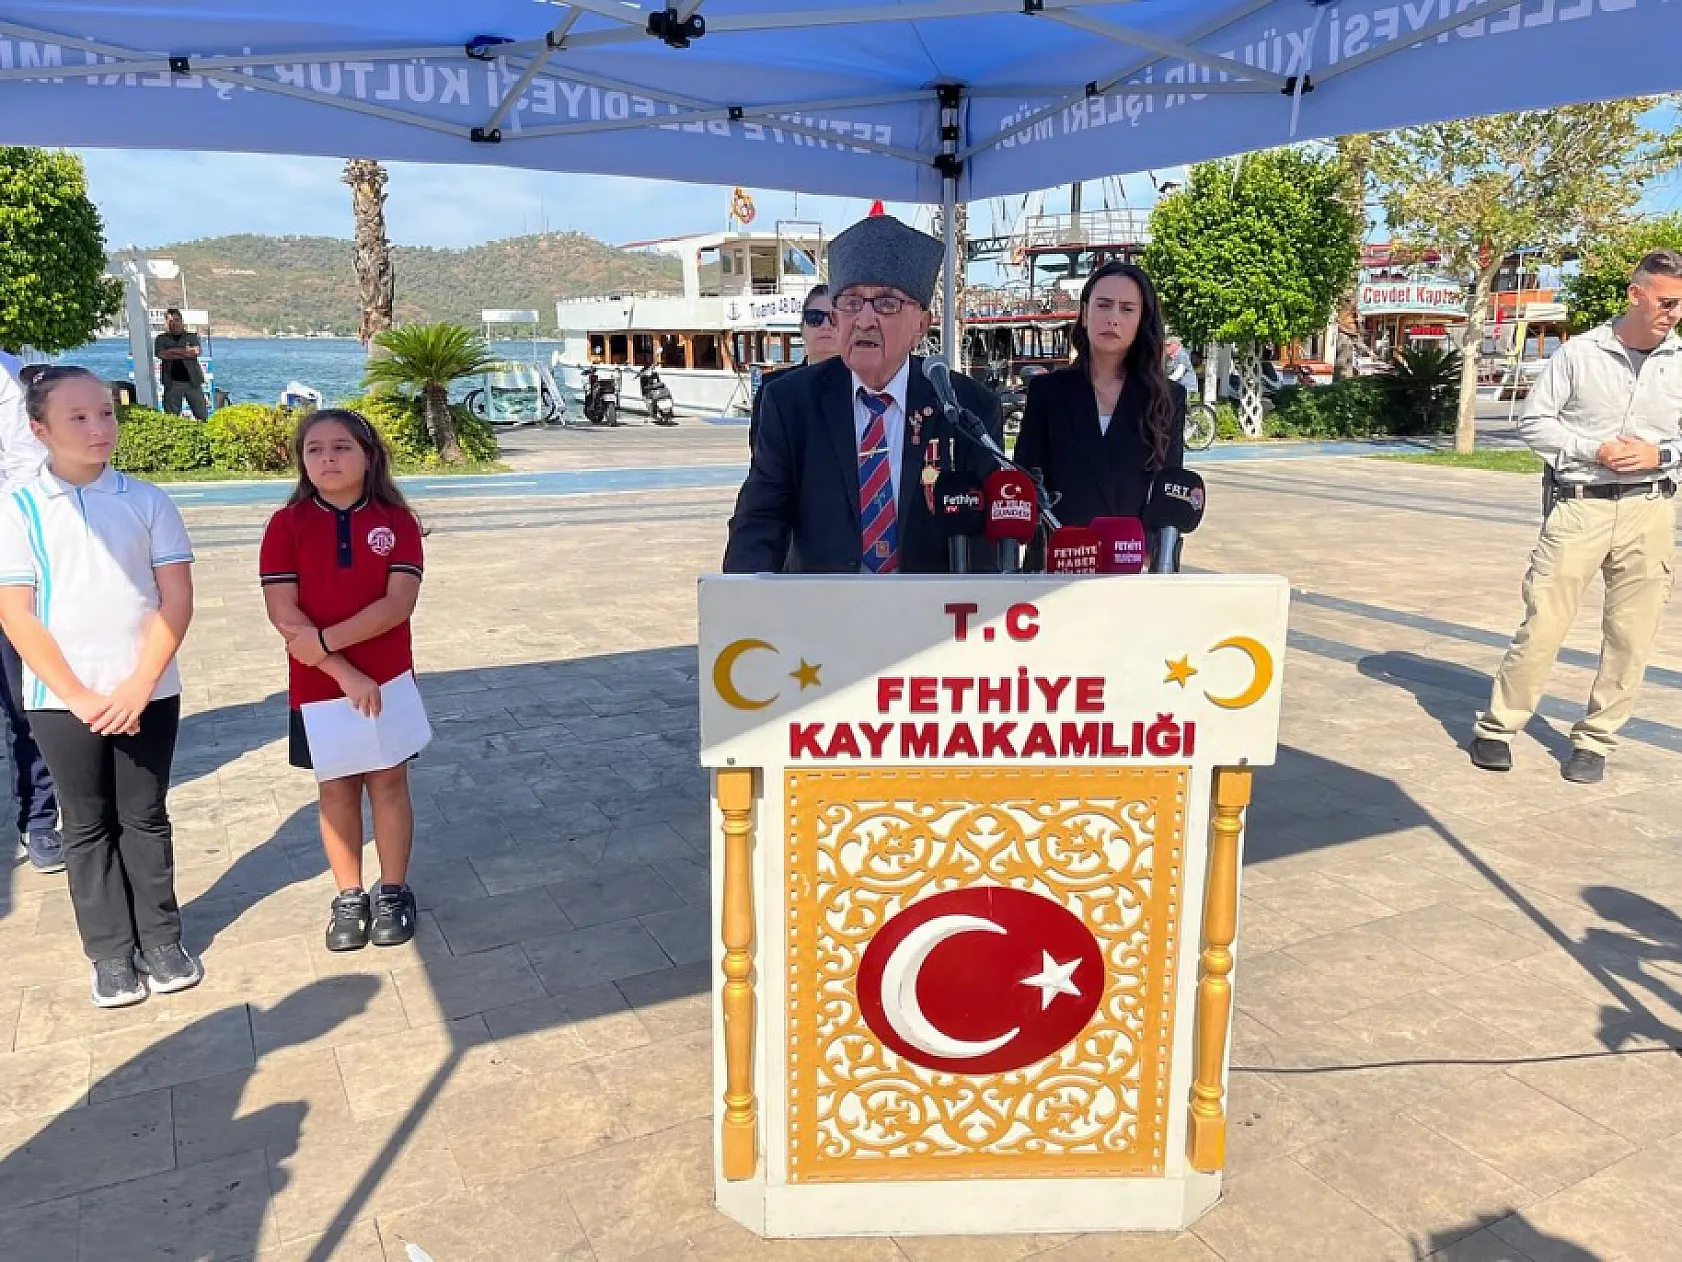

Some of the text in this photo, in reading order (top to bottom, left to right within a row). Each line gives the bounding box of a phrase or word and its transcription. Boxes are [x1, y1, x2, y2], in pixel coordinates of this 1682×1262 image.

[1363, 287, 1411, 305] Cevdet
[1054, 544, 1098, 559] FETHİYE
[1057, 556, 1096, 569] HABER
[876, 664, 1106, 714] FETHİYE
[788, 713, 1196, 759] KAYMAKAMLIĞI
